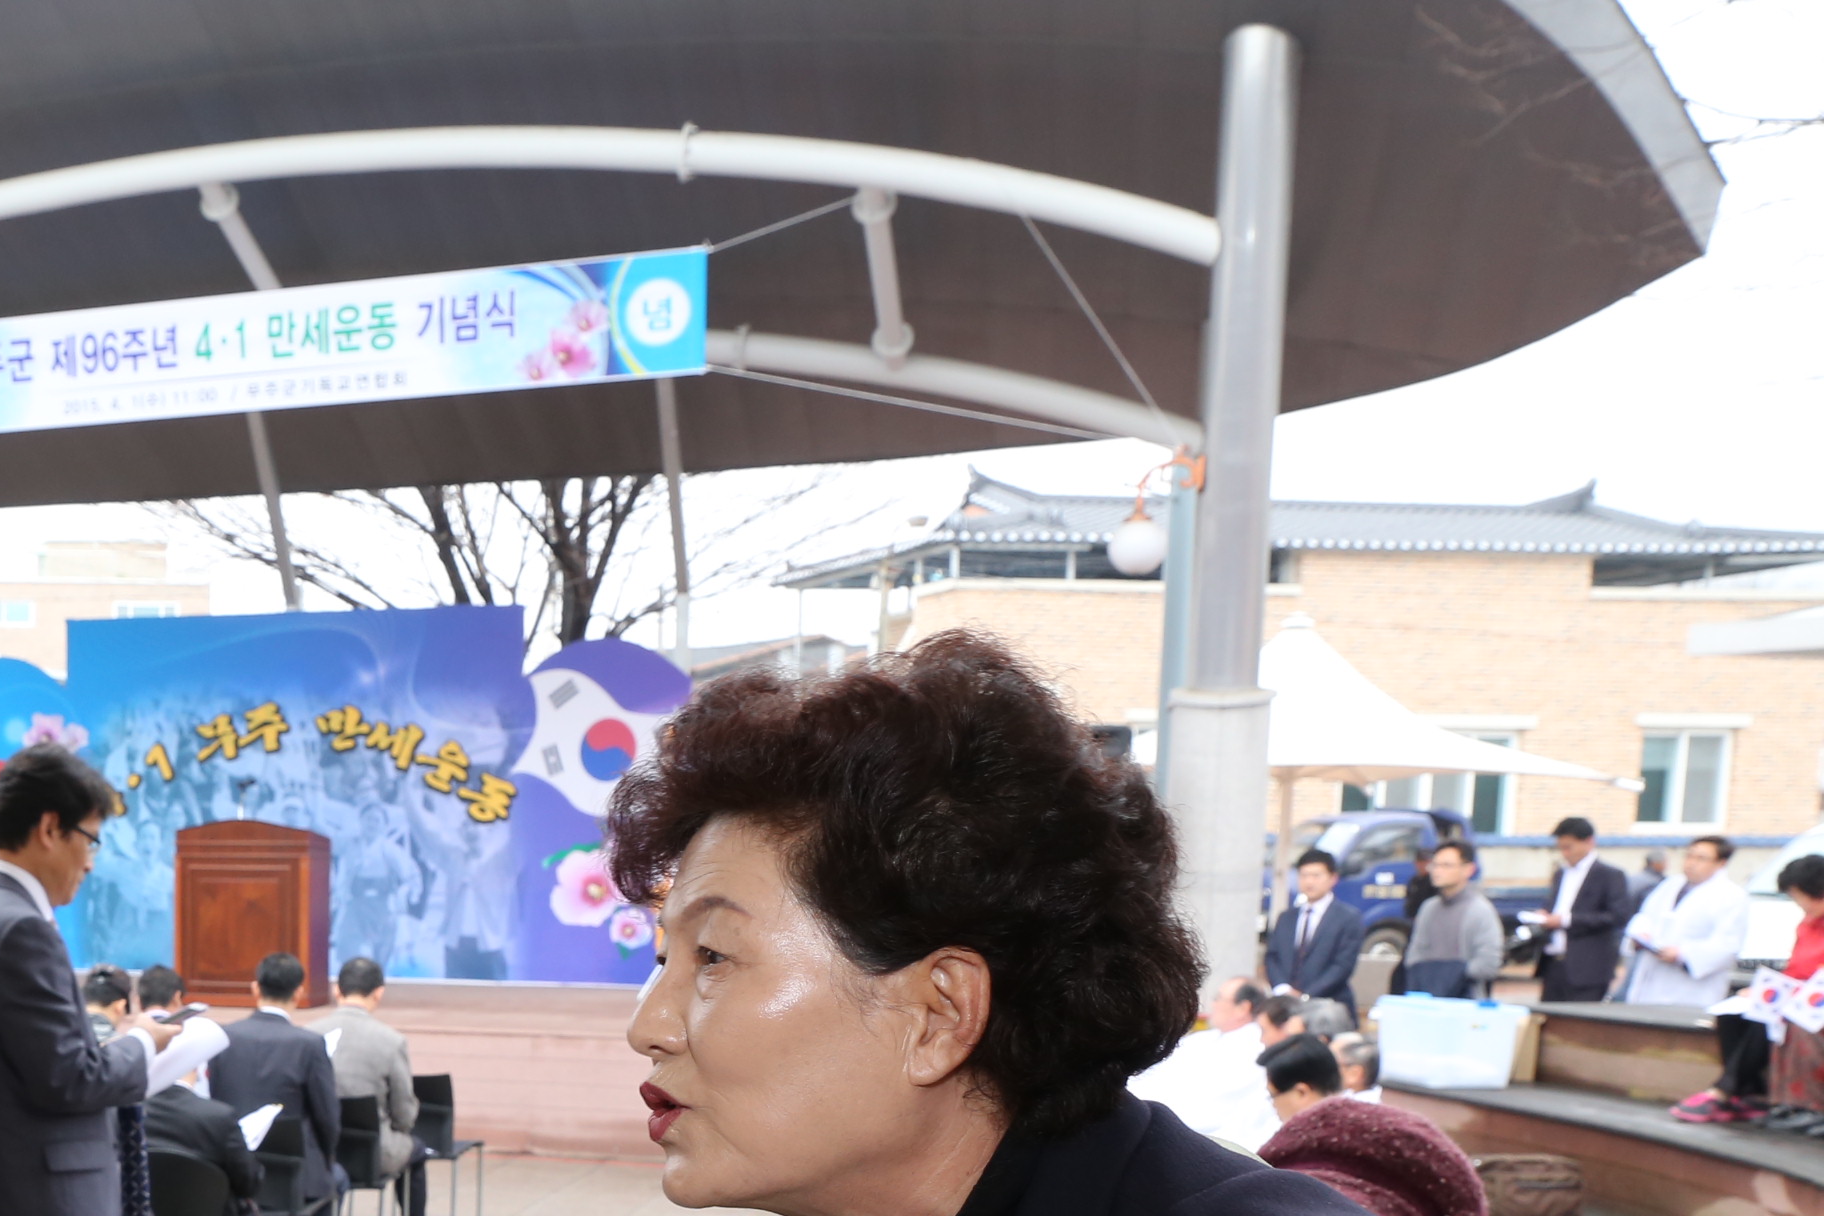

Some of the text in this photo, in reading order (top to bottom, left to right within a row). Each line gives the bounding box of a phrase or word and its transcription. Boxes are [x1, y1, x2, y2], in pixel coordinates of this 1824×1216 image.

[52, 325, 178, 377] 제96주년
[267, 301, 398, 360] 만세운동
[417, 288, 517, 346] 기념식
[195, 700, 291, 763] 무주
[315, 703, 518, 824] 만세운동
